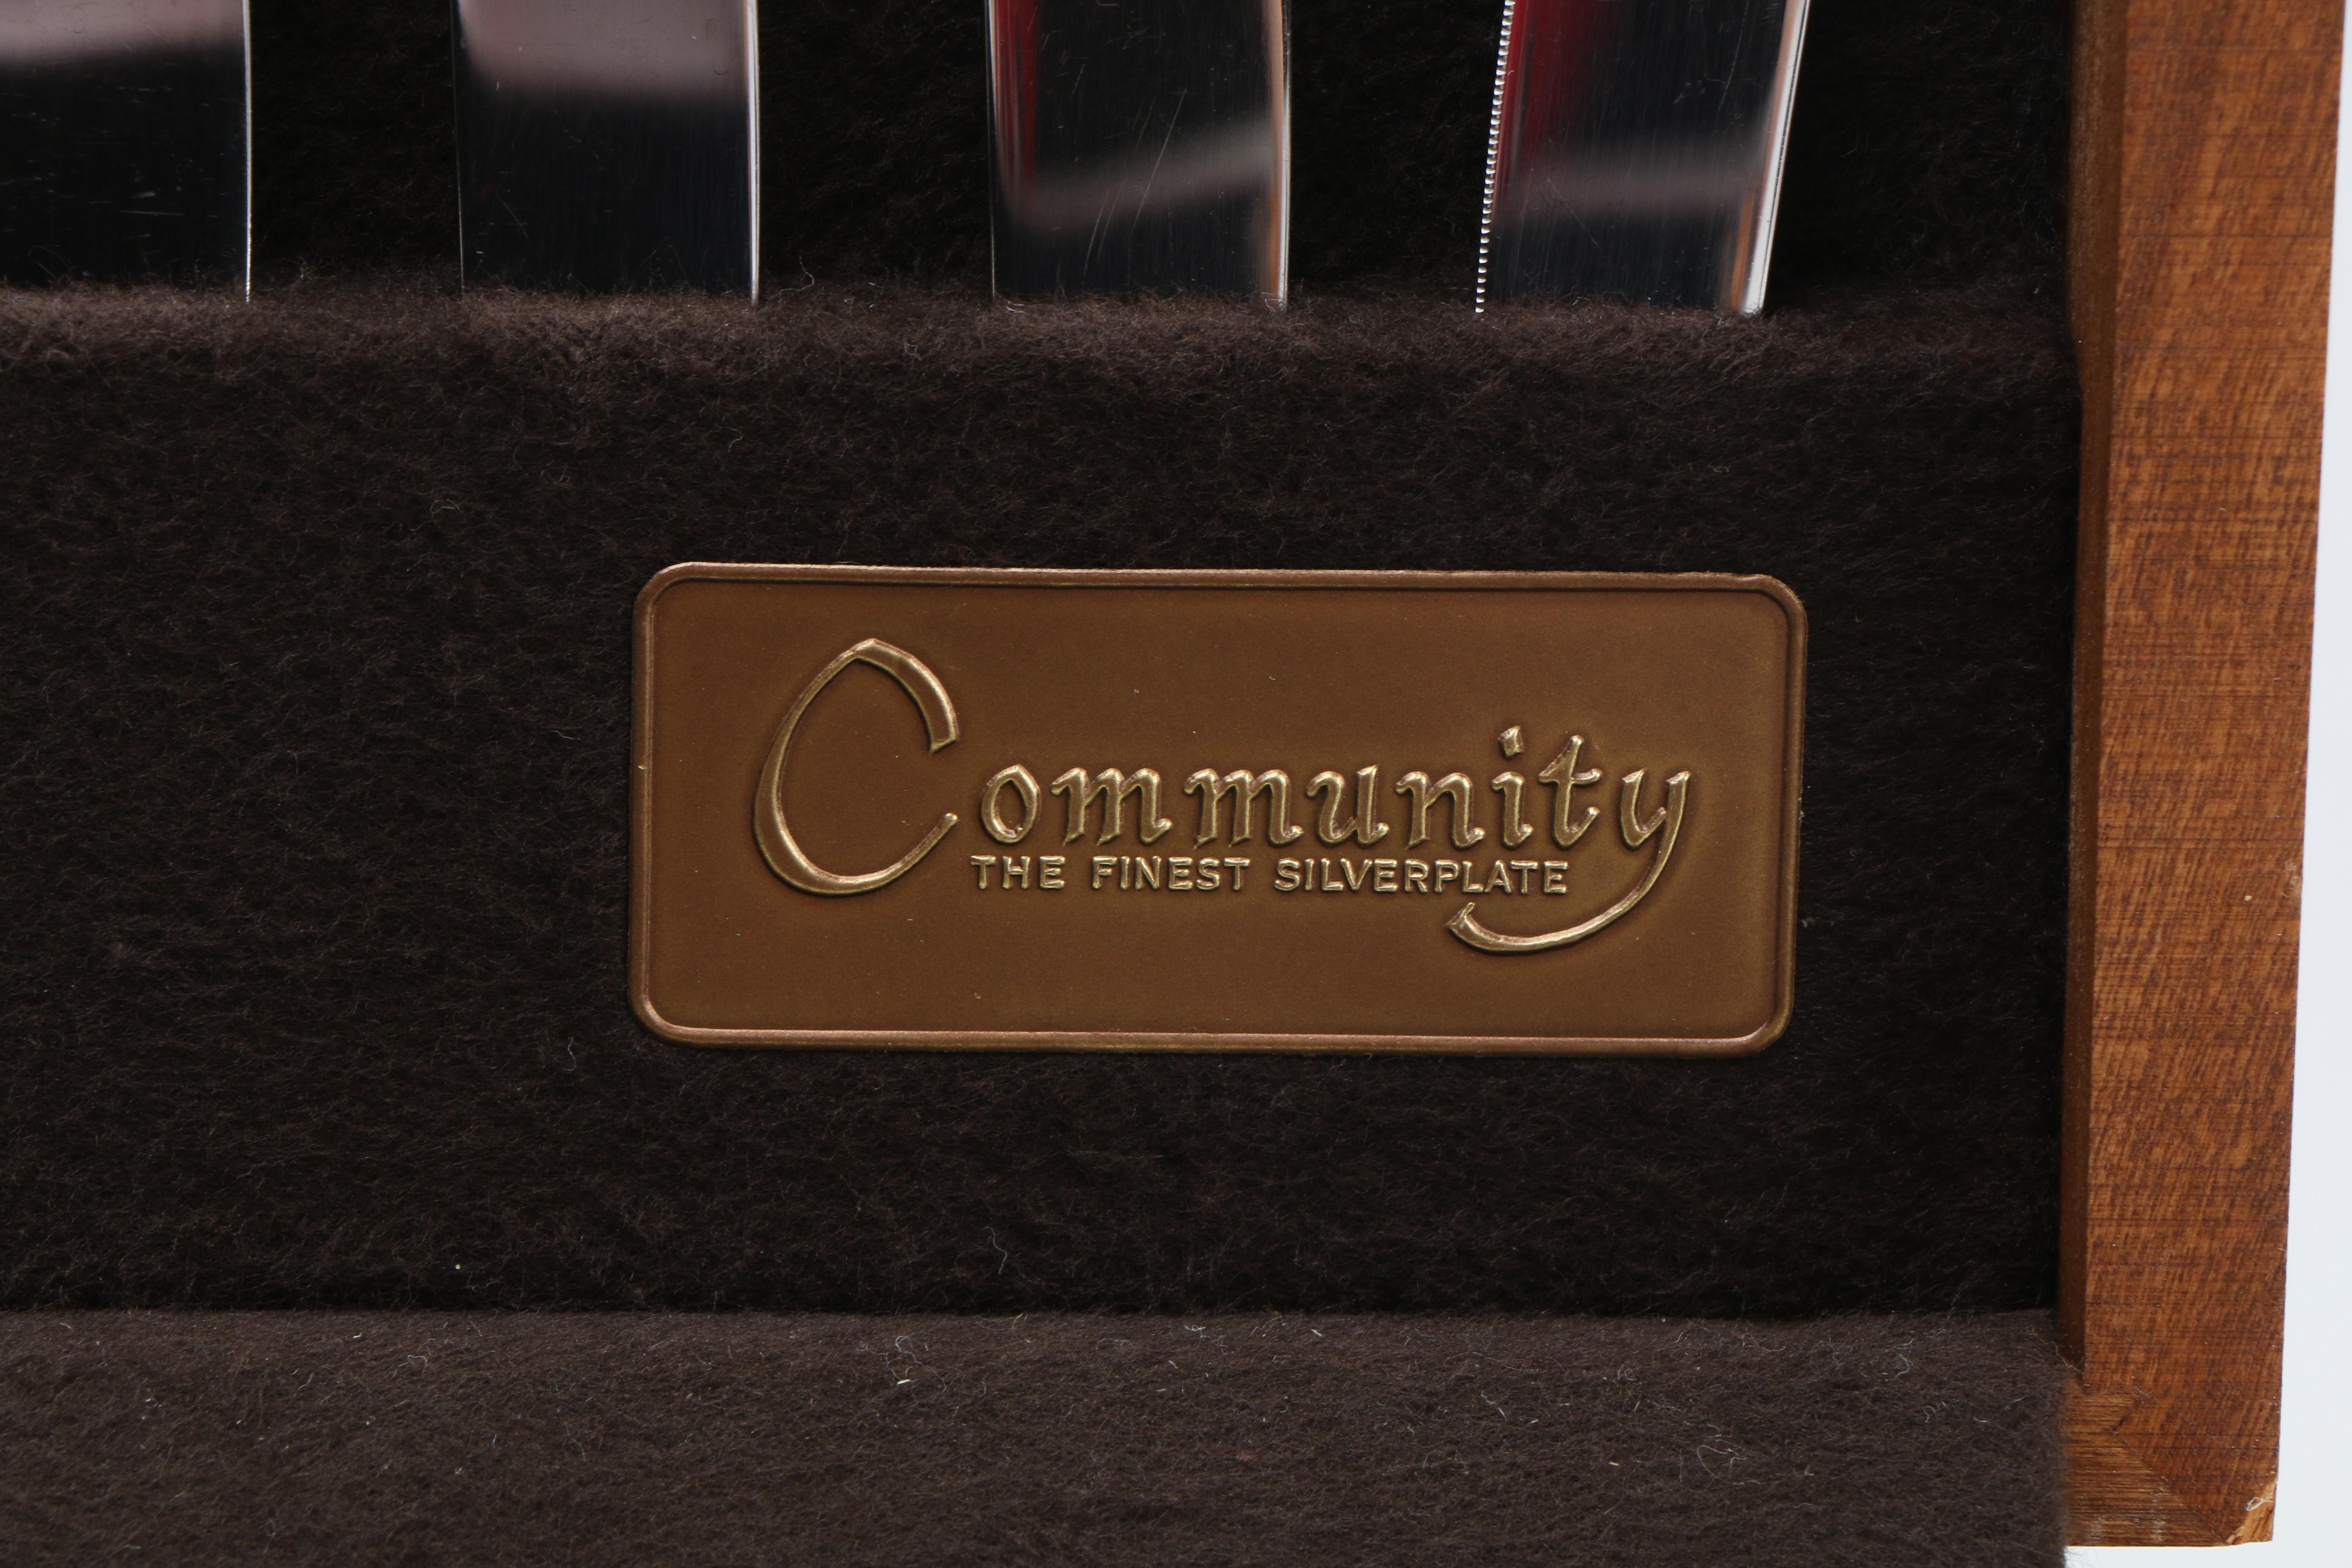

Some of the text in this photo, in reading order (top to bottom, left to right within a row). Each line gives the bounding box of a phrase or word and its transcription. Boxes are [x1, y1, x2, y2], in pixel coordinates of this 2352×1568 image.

[752, 638, 1693, 952] Community
[970, 854, 1570, 895] THE FINEST SILVERPLATE
